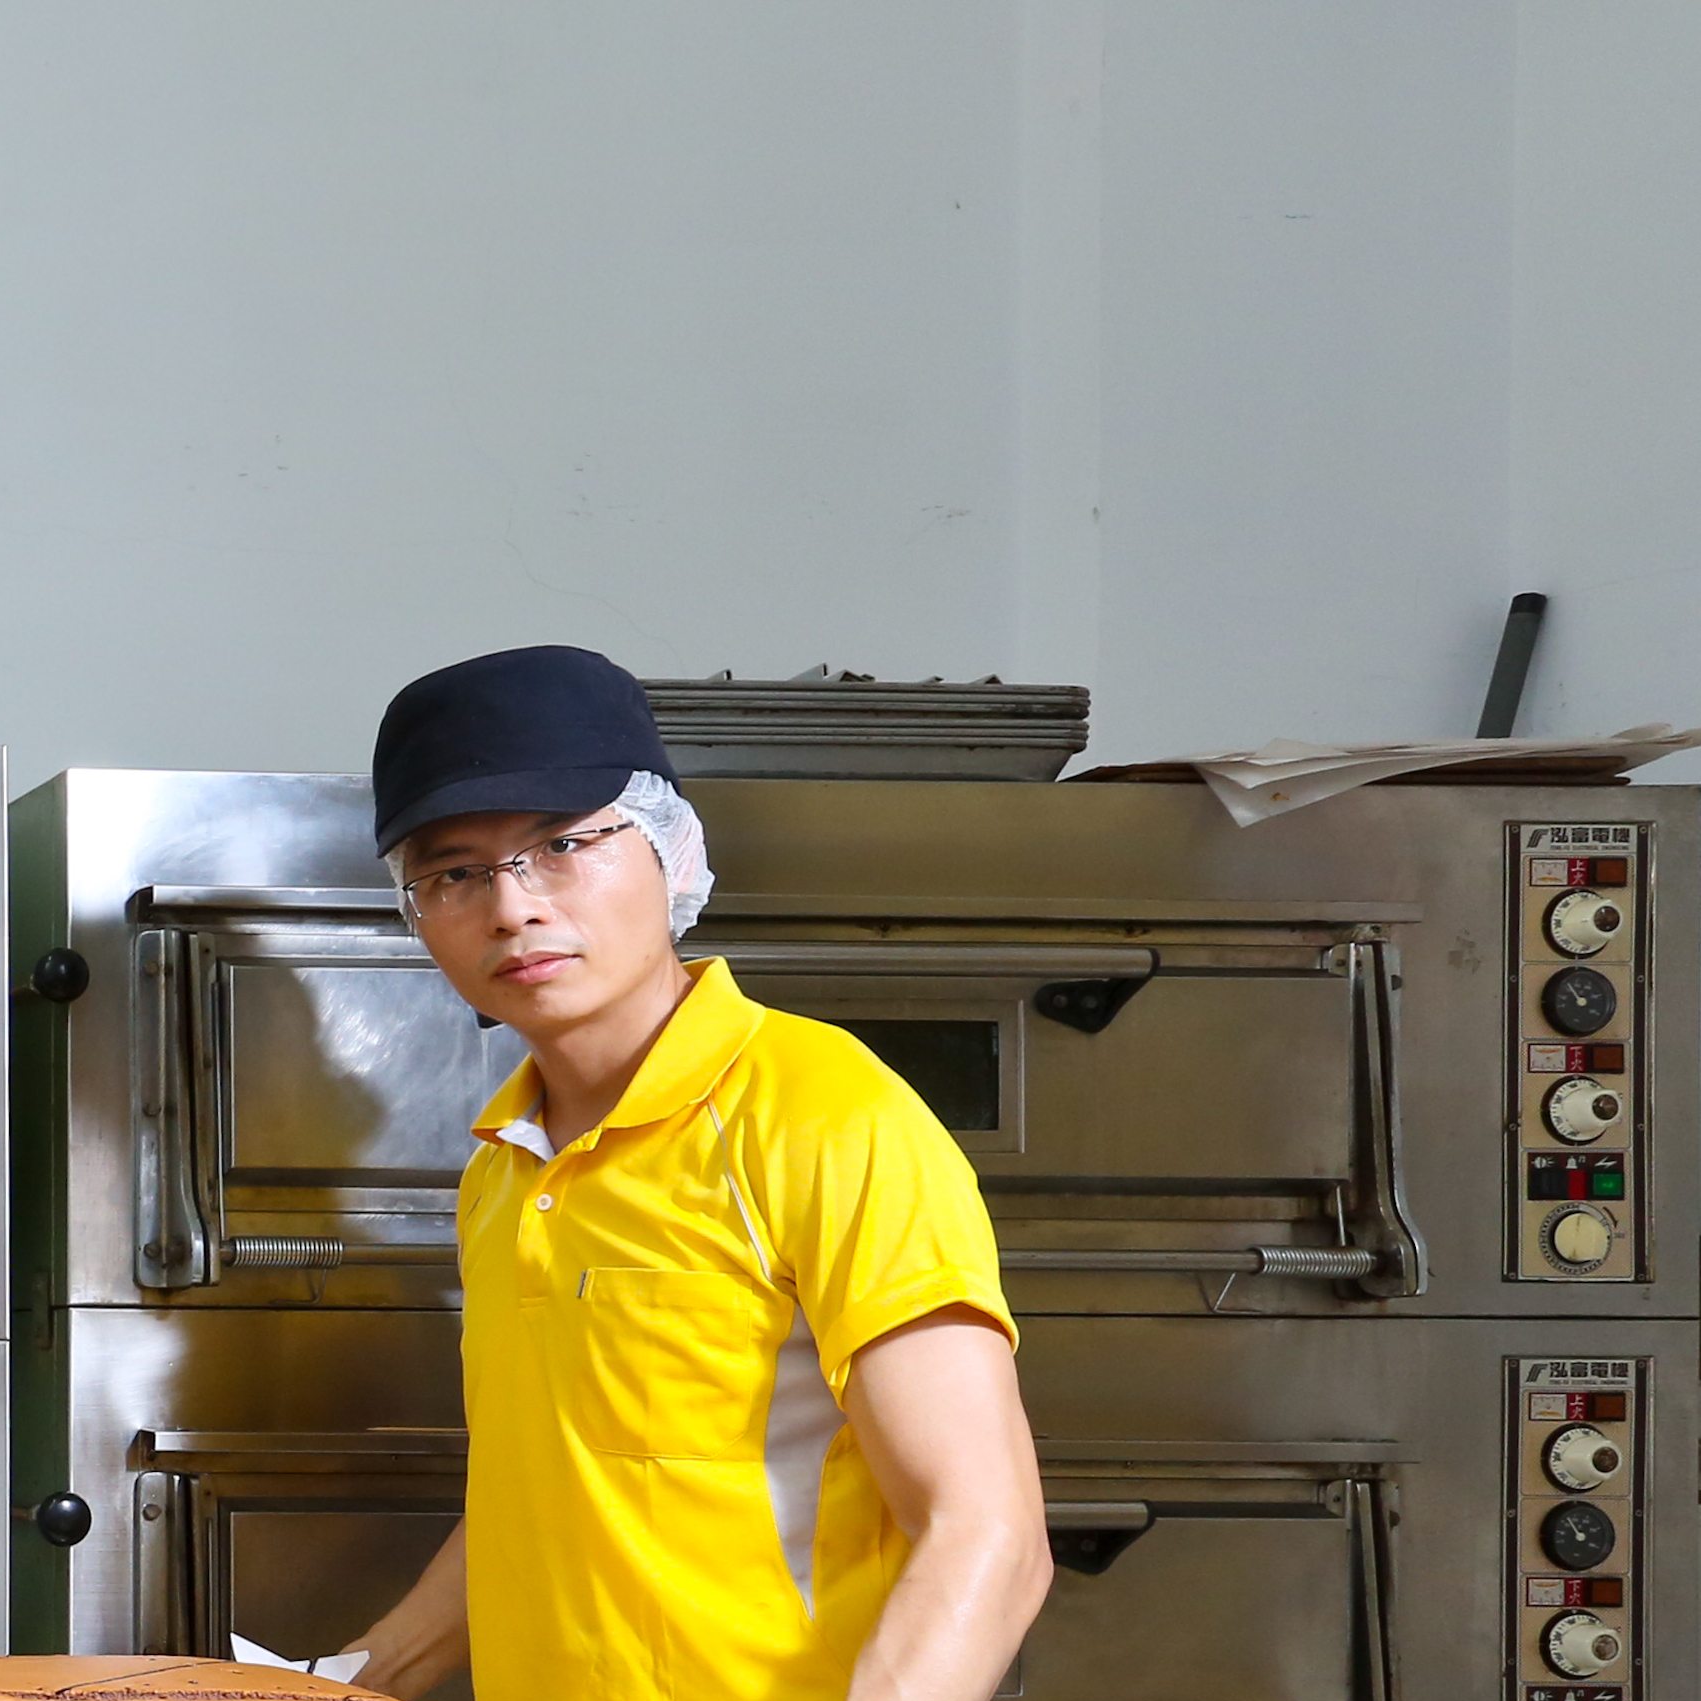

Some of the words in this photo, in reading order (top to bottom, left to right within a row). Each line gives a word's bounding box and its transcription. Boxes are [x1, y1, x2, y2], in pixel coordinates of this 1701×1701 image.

[1571, 860, 1586, 885] 上火
[1570, 1046, 1583, 1071] 下火
[1569, 1394, 1584, 1419] 上火
[1568, 1580, 1582, 1605] 下火
